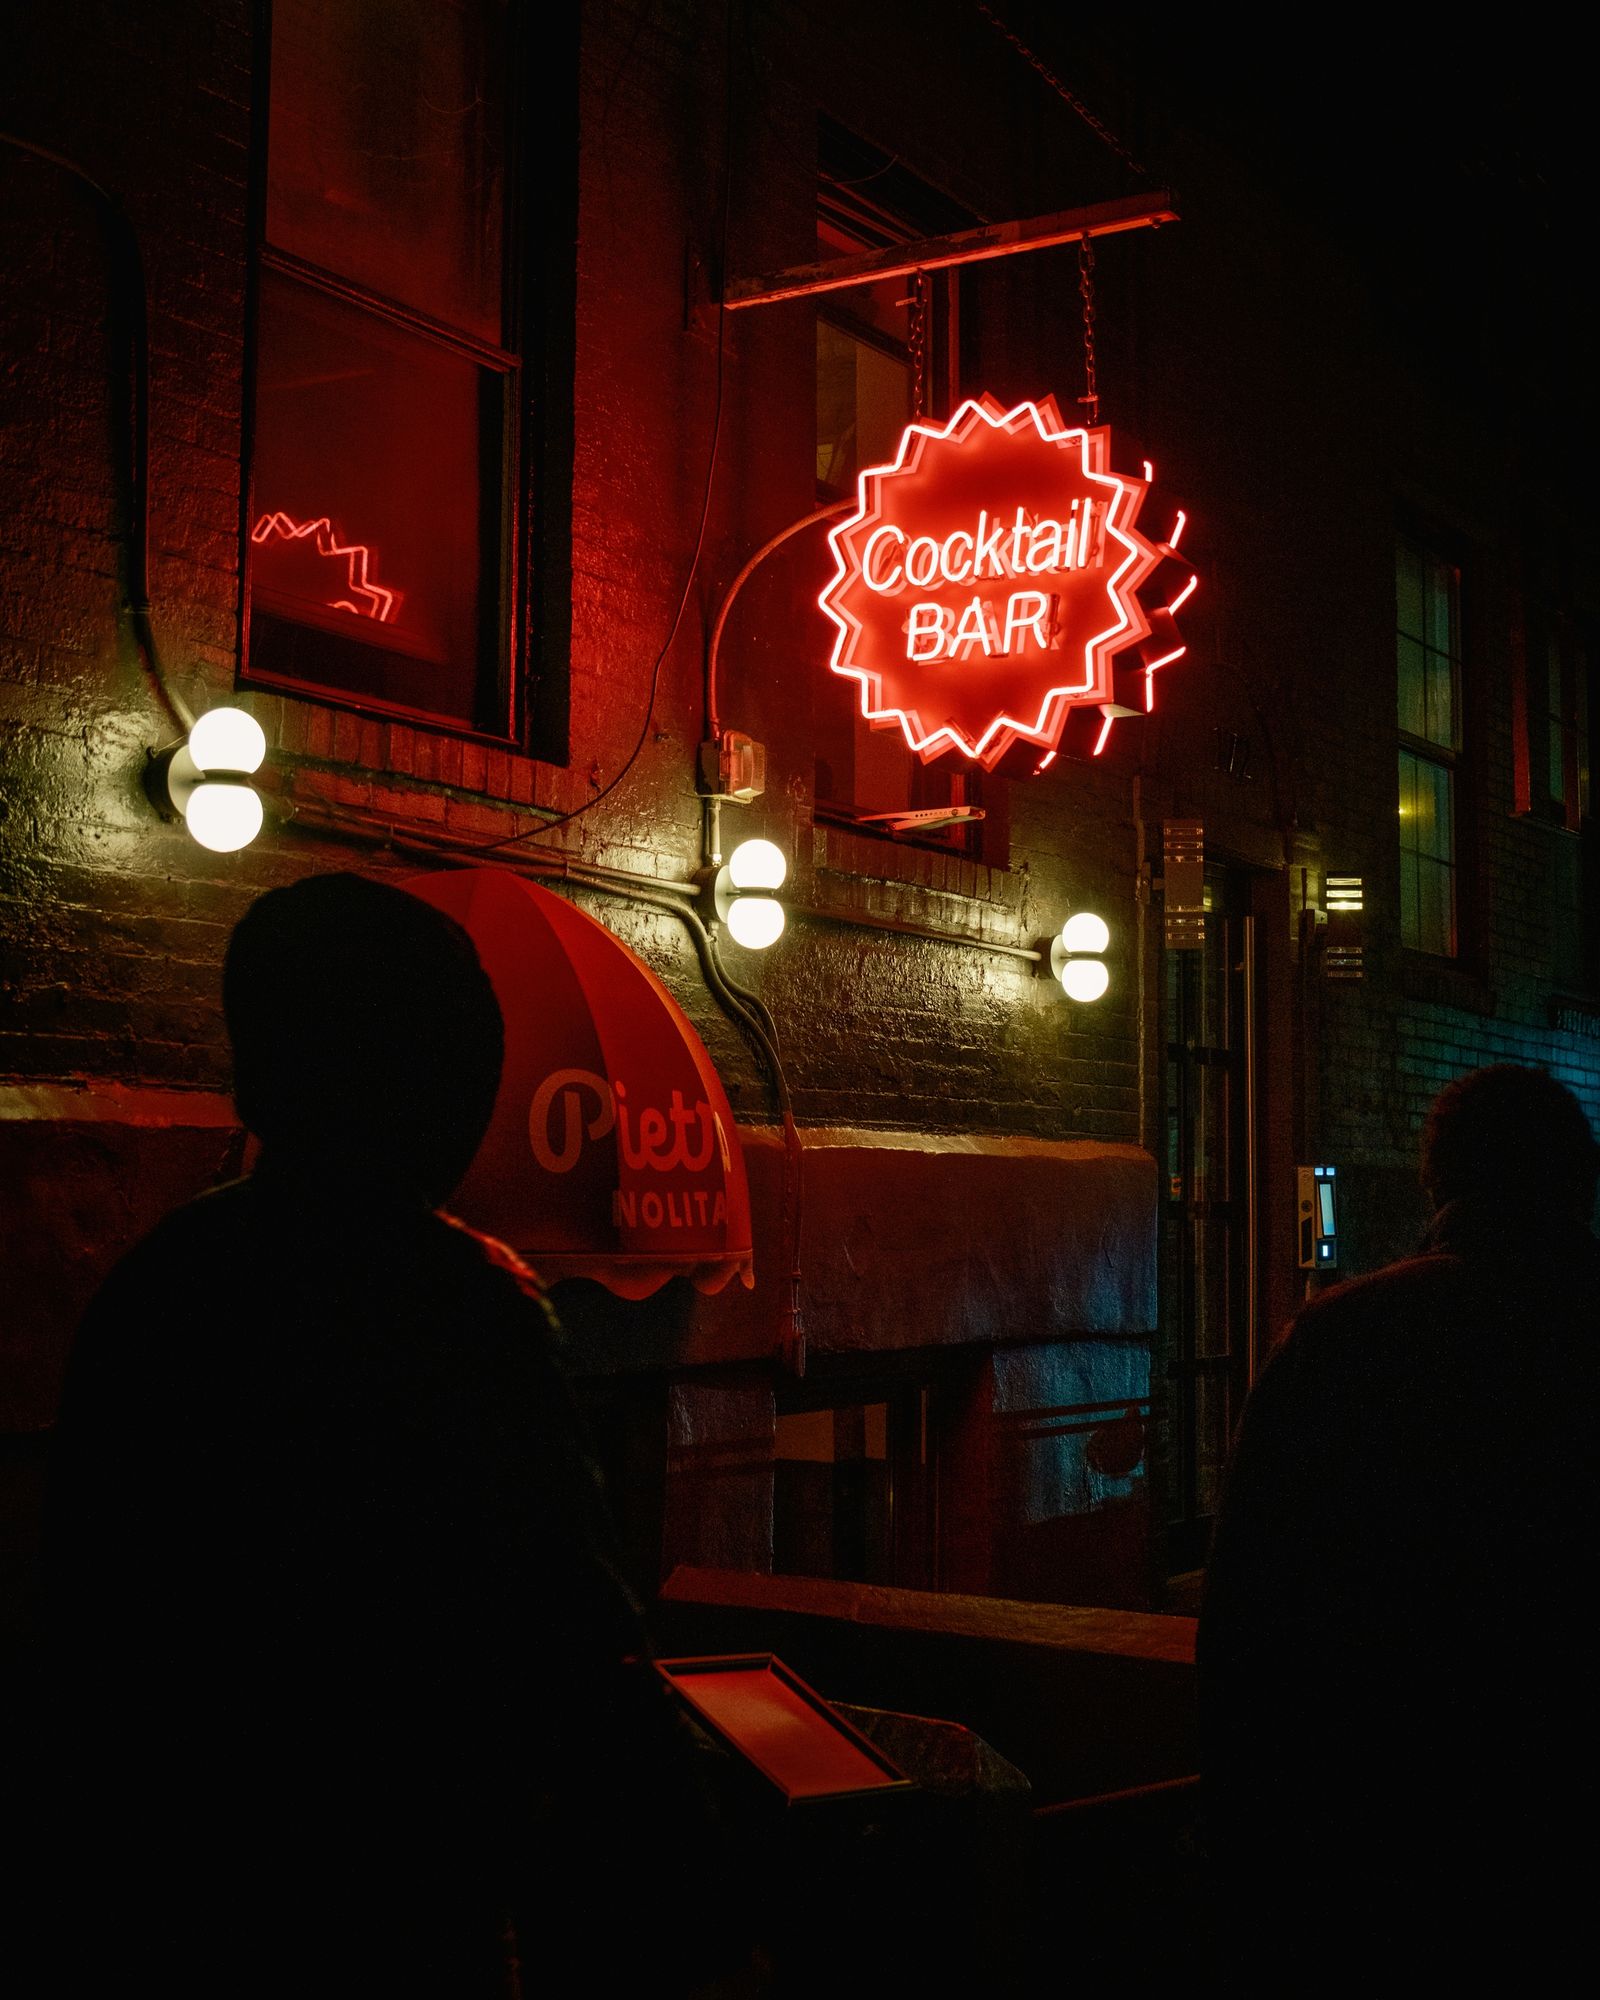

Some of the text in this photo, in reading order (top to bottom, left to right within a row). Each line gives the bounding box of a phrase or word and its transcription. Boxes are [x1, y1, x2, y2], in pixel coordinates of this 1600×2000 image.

[862, 497, 1093, 591] Cocktail
[906, 590, 1048, 661] BAR
[613, 1190, 728, 1229] NOLITA
